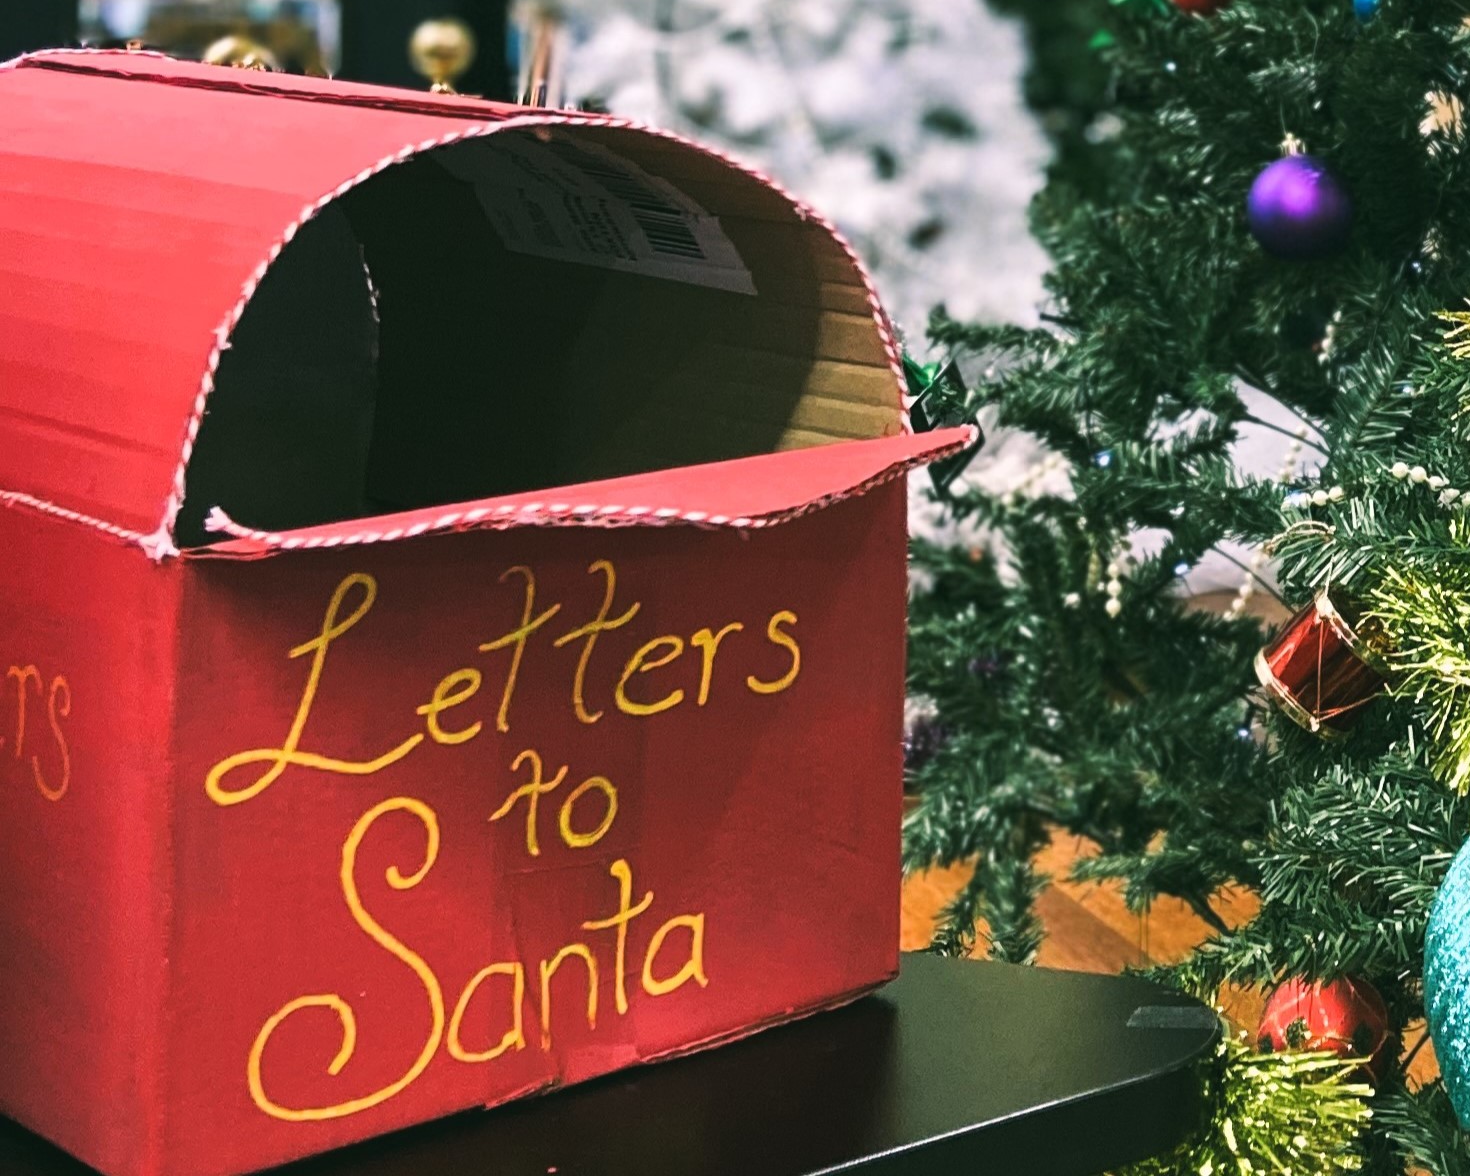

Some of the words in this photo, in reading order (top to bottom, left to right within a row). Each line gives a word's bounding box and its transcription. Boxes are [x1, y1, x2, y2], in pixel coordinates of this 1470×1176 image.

[0, 664, 71, 802] rs
[205, 560, 802, 805] Letters
[489, 750, 618, 856] to
[247, 796, 708, 1122] Santa
